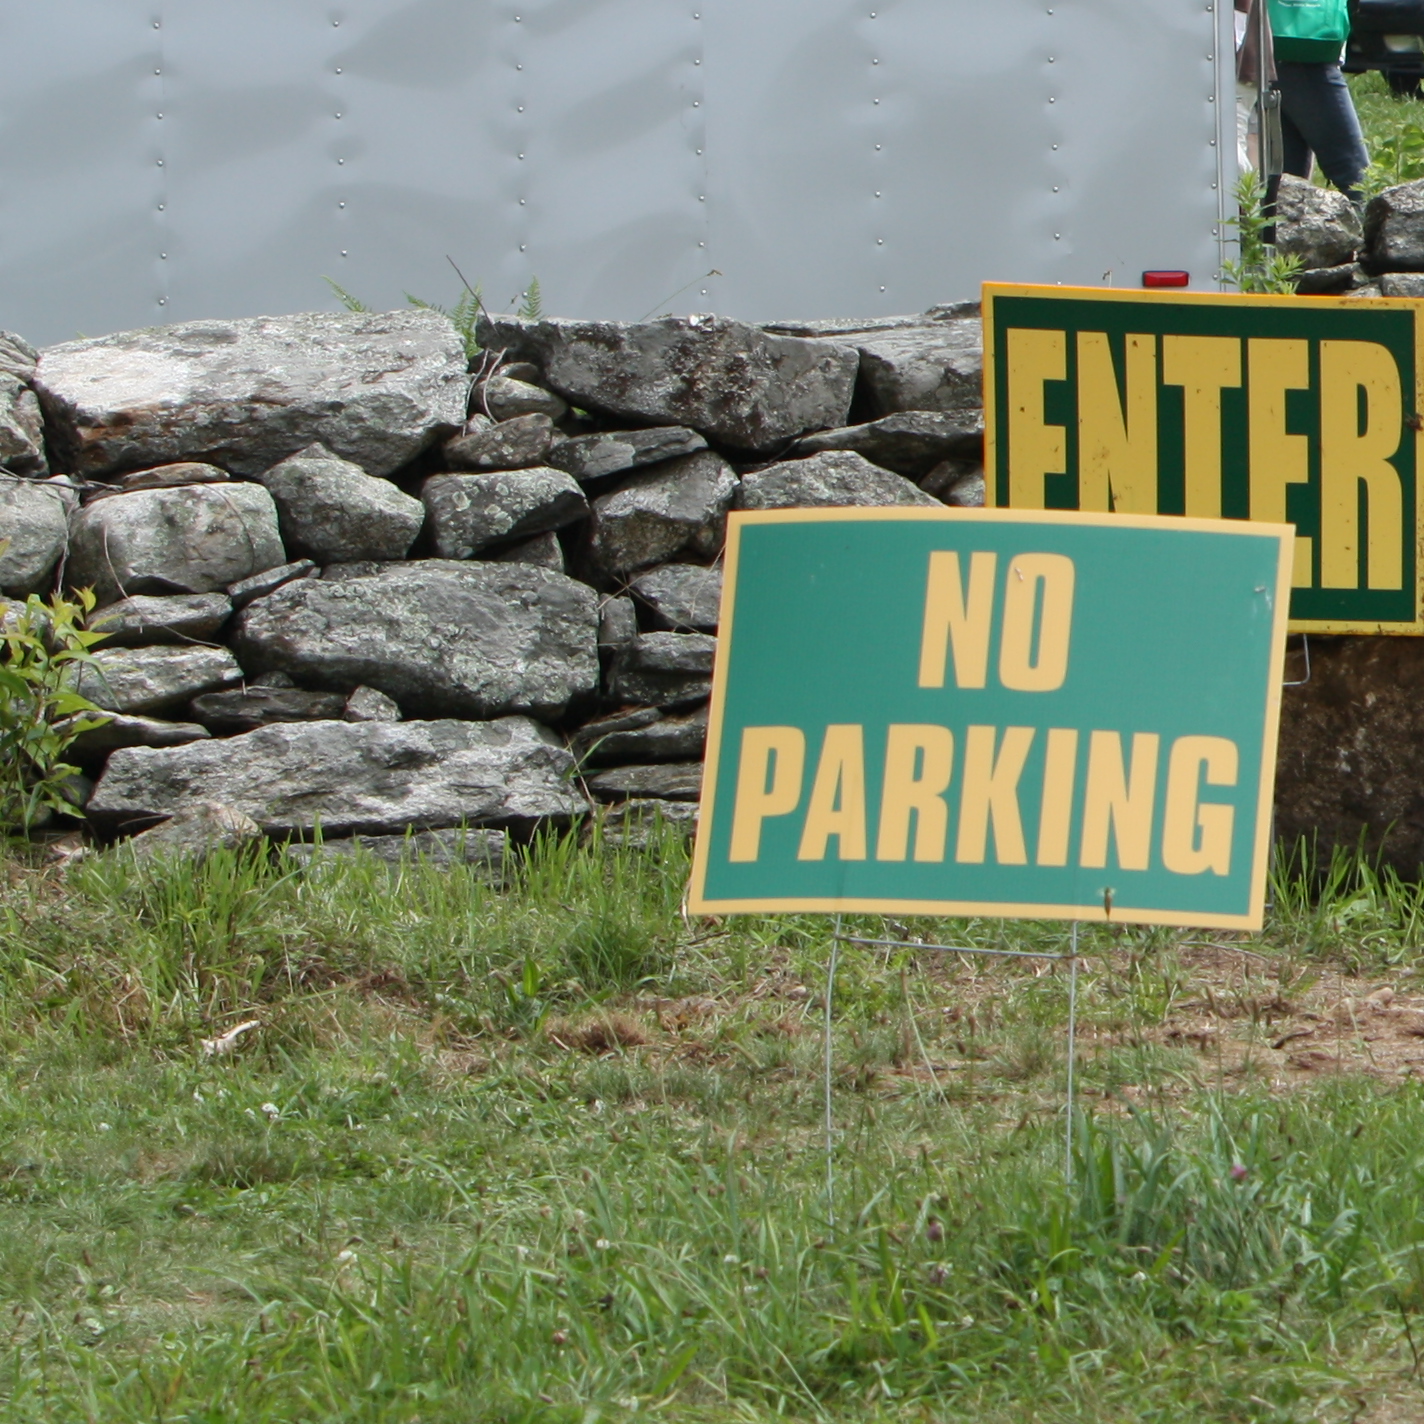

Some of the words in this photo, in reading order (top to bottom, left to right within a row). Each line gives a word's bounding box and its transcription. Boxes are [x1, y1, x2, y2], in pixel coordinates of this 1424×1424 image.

[1006, 327, 1404, 590] ENTER
[918, 550, 1075, 692] NO
[729, 724, 1239, 876] PARKING
